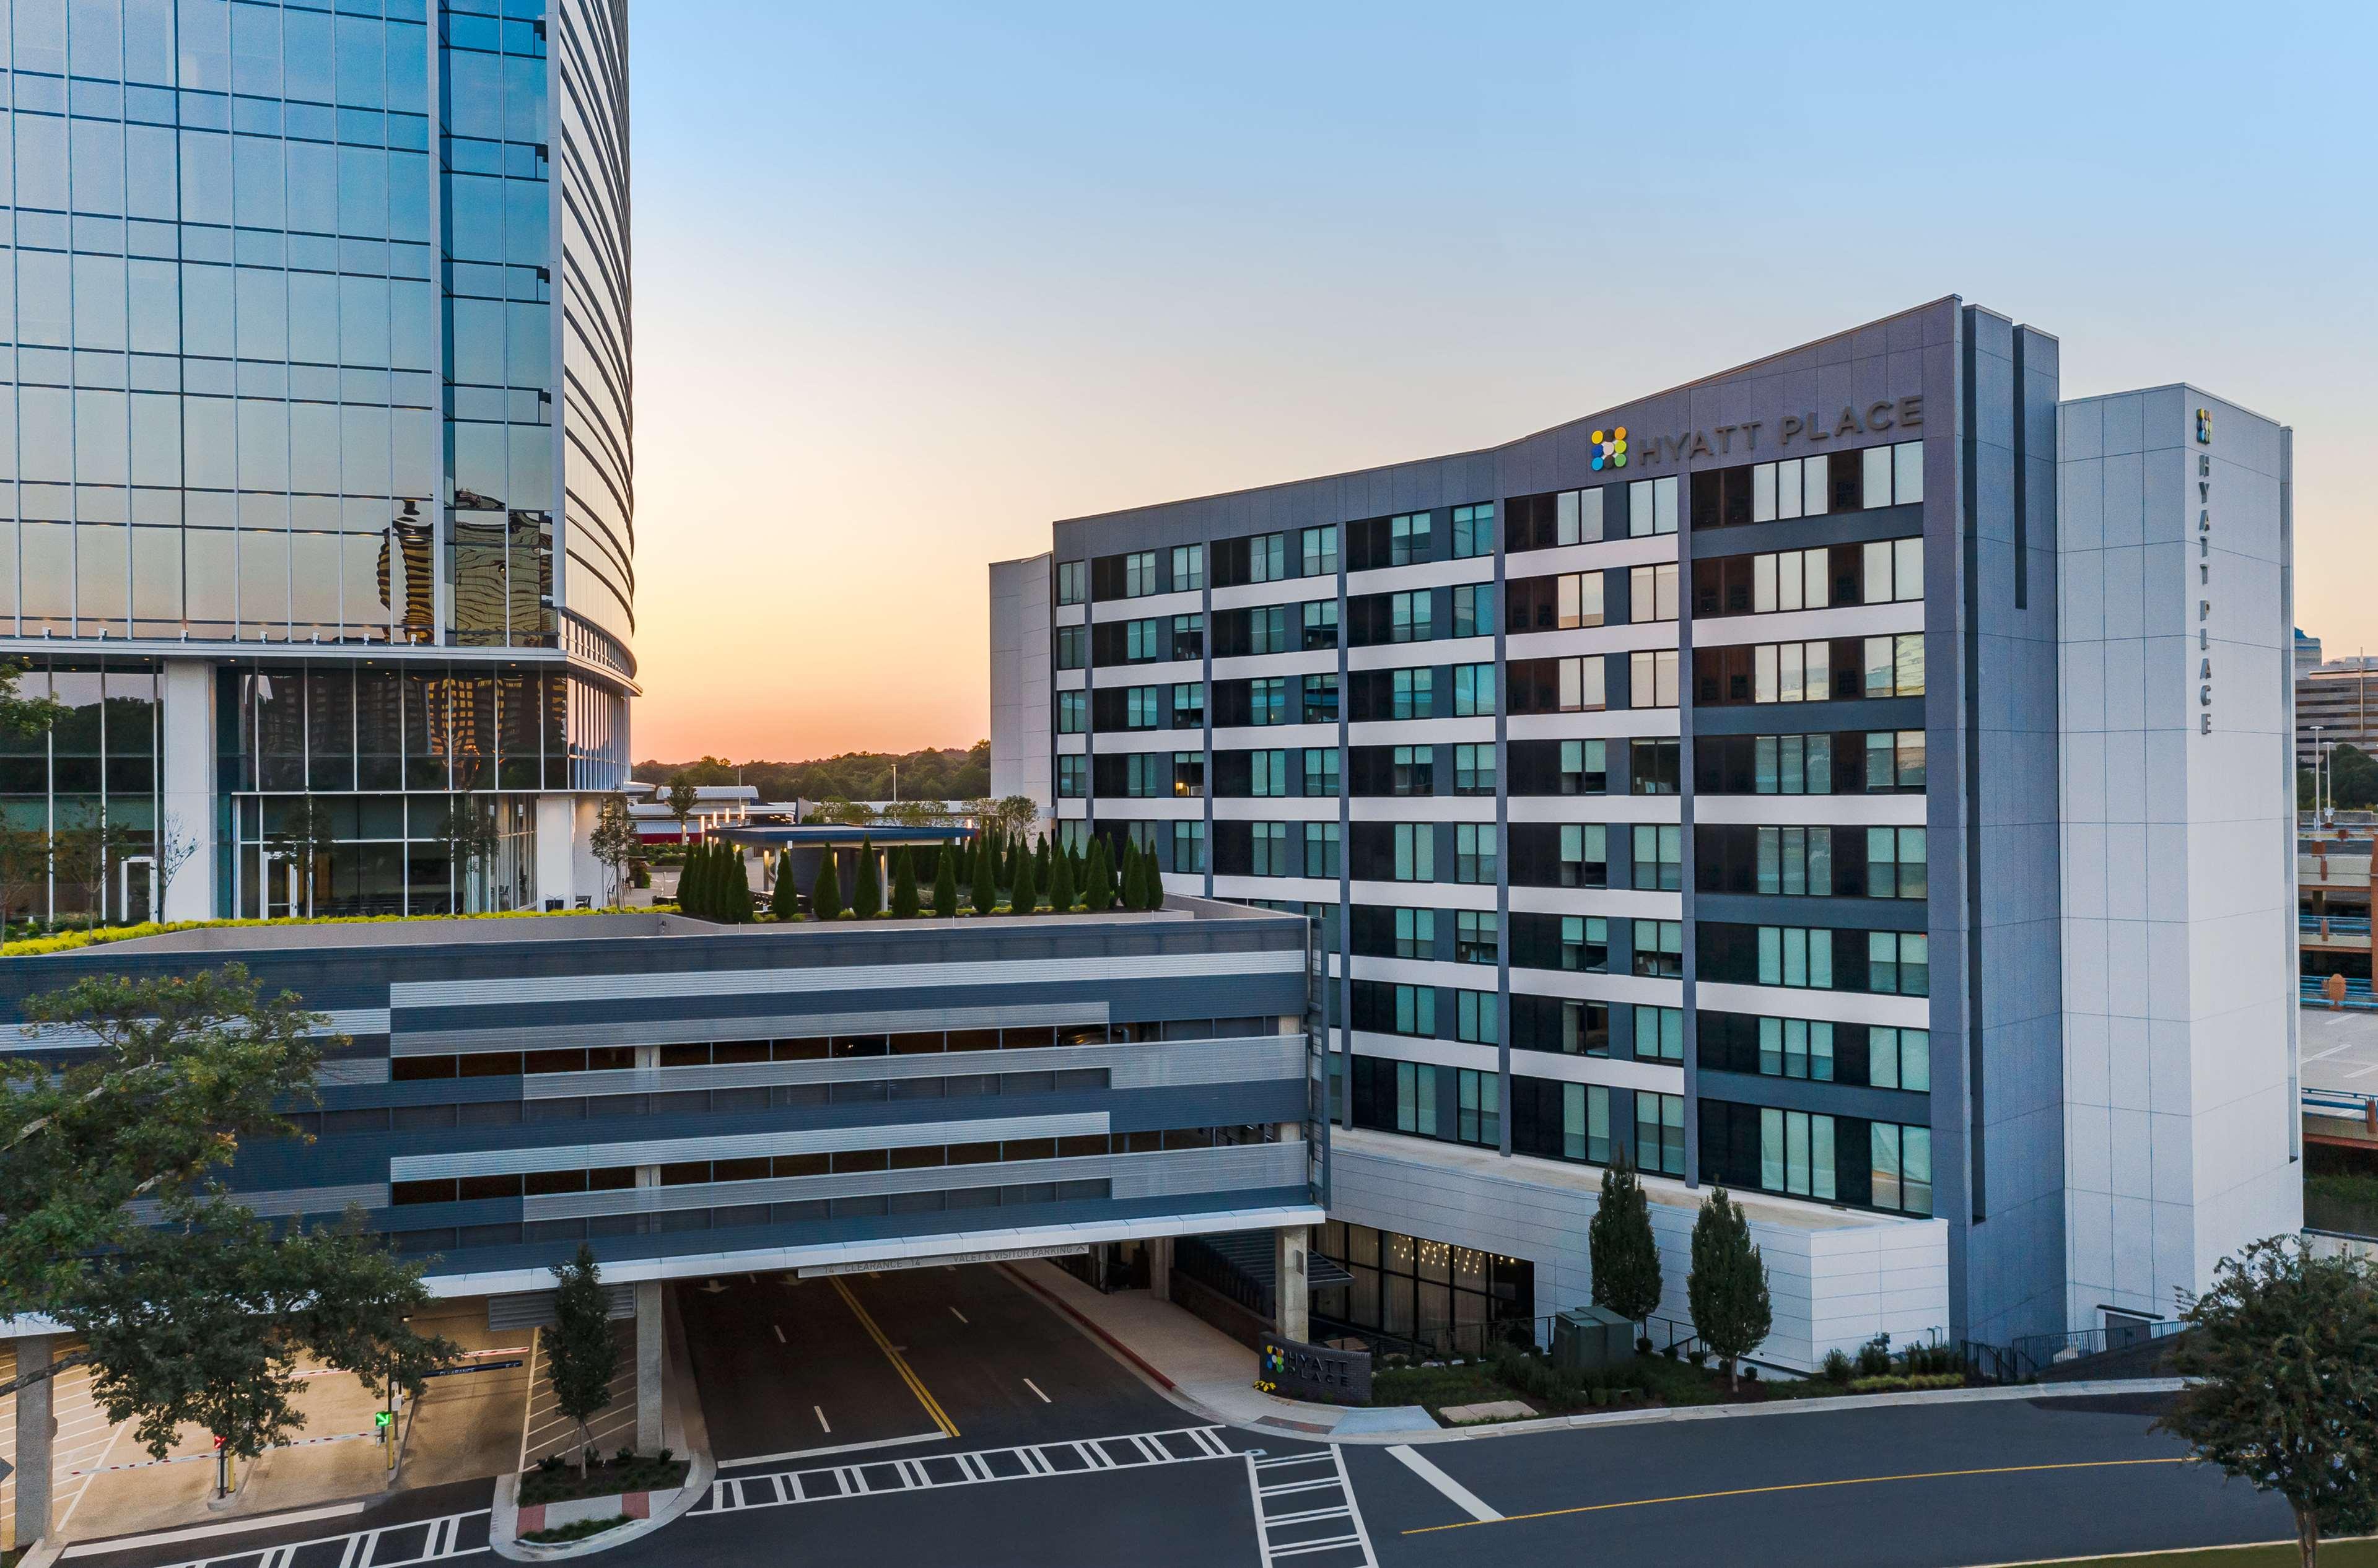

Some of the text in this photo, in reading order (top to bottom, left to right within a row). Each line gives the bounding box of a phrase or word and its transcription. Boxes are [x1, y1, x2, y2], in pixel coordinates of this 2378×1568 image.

[1638, 394, 1923, 466] HYATT PLACE
[2199, 455, 2211, 734] HYATT PLACE
[952, 1254, 981, 1263] VALET
[995, 1249, 1029, 1260] VISITOR
[1033, 1245, 1072, 1257] PARKING
[845, 1261, 902, 1272] CLEARANCE
[1289, 1352, 1348, 1374] HYATT
[1289, 1367, 1348, 1386] PLACE
